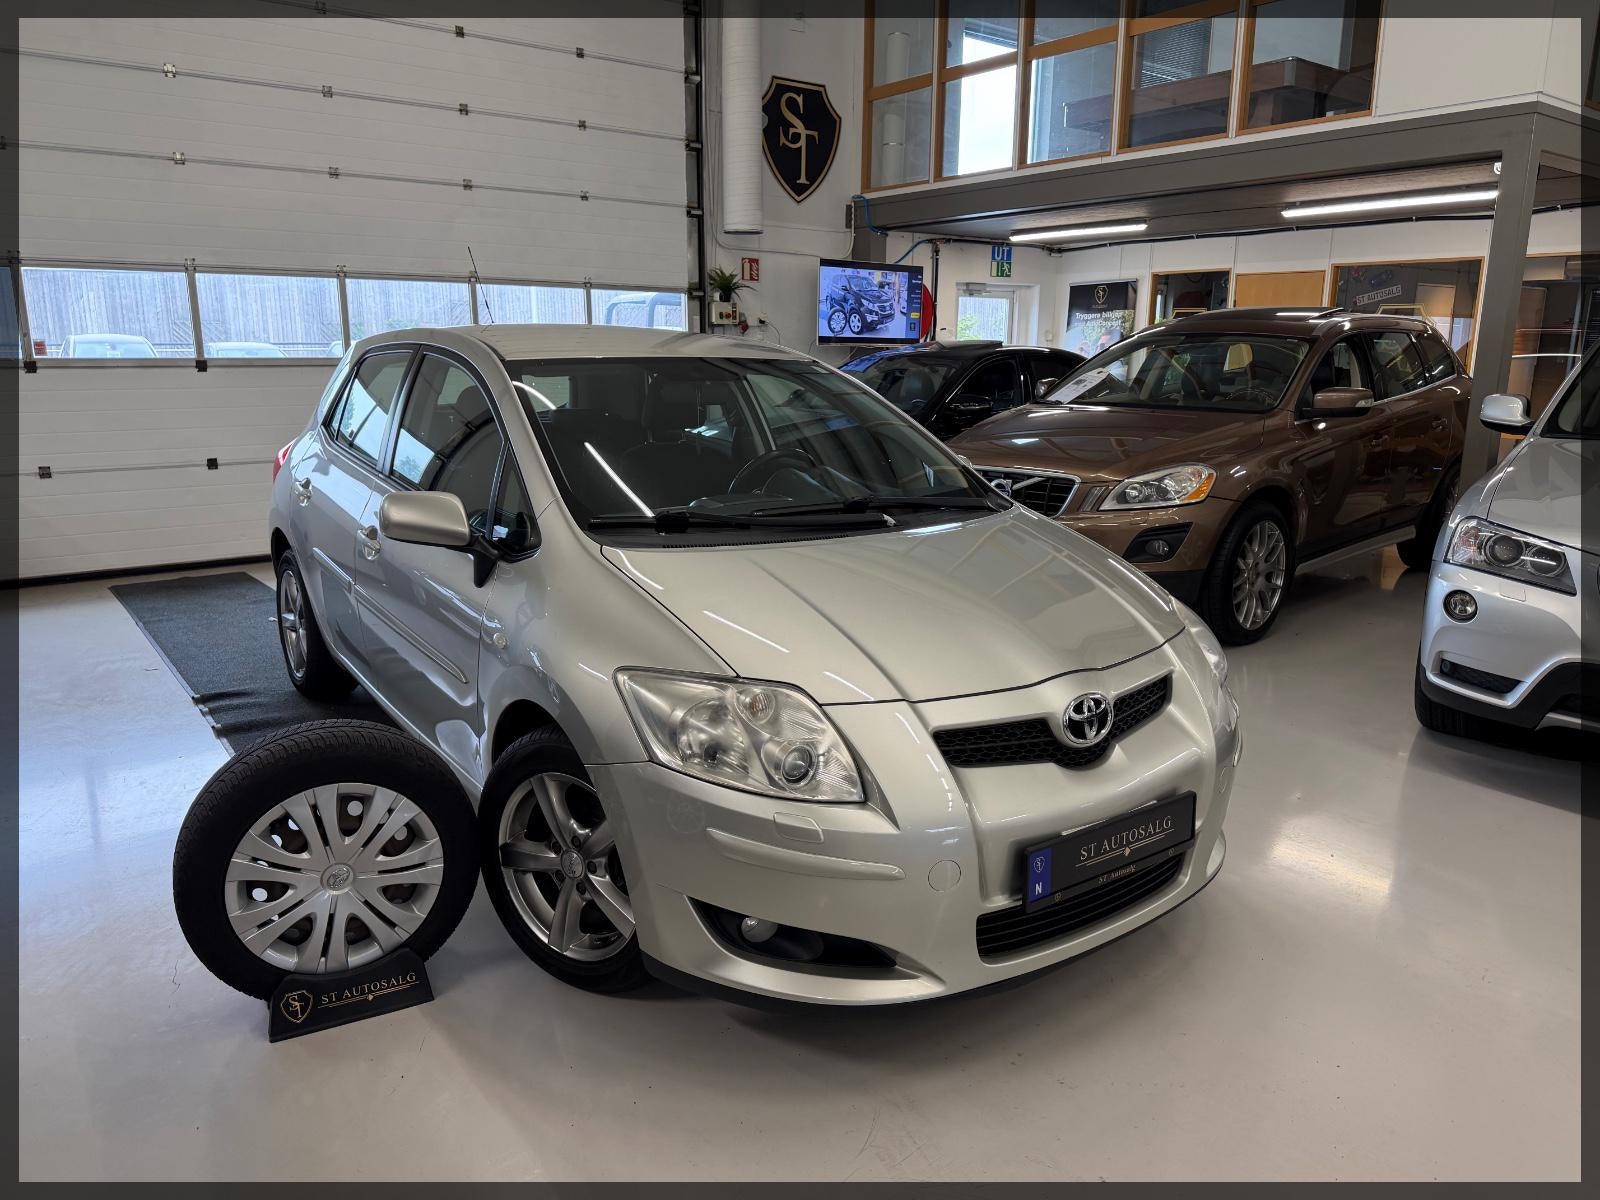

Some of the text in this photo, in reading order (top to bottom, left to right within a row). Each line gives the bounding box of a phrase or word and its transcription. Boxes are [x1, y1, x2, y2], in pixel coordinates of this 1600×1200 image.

[780, 92, 819, 185] ST
[995, 246, 1010, 260] UT
[1357, 286, 1401, 305] ST AUTOSALG
[1075, 312, 1101, 320] Tryggere
[1080, 815, 1173, 861] ST AUTOSALG
[1035, 881, 1043, 896] N
[321, 972, 417, 1005] ST AUTOSALG
[288, 994, 305, 1019] ST
